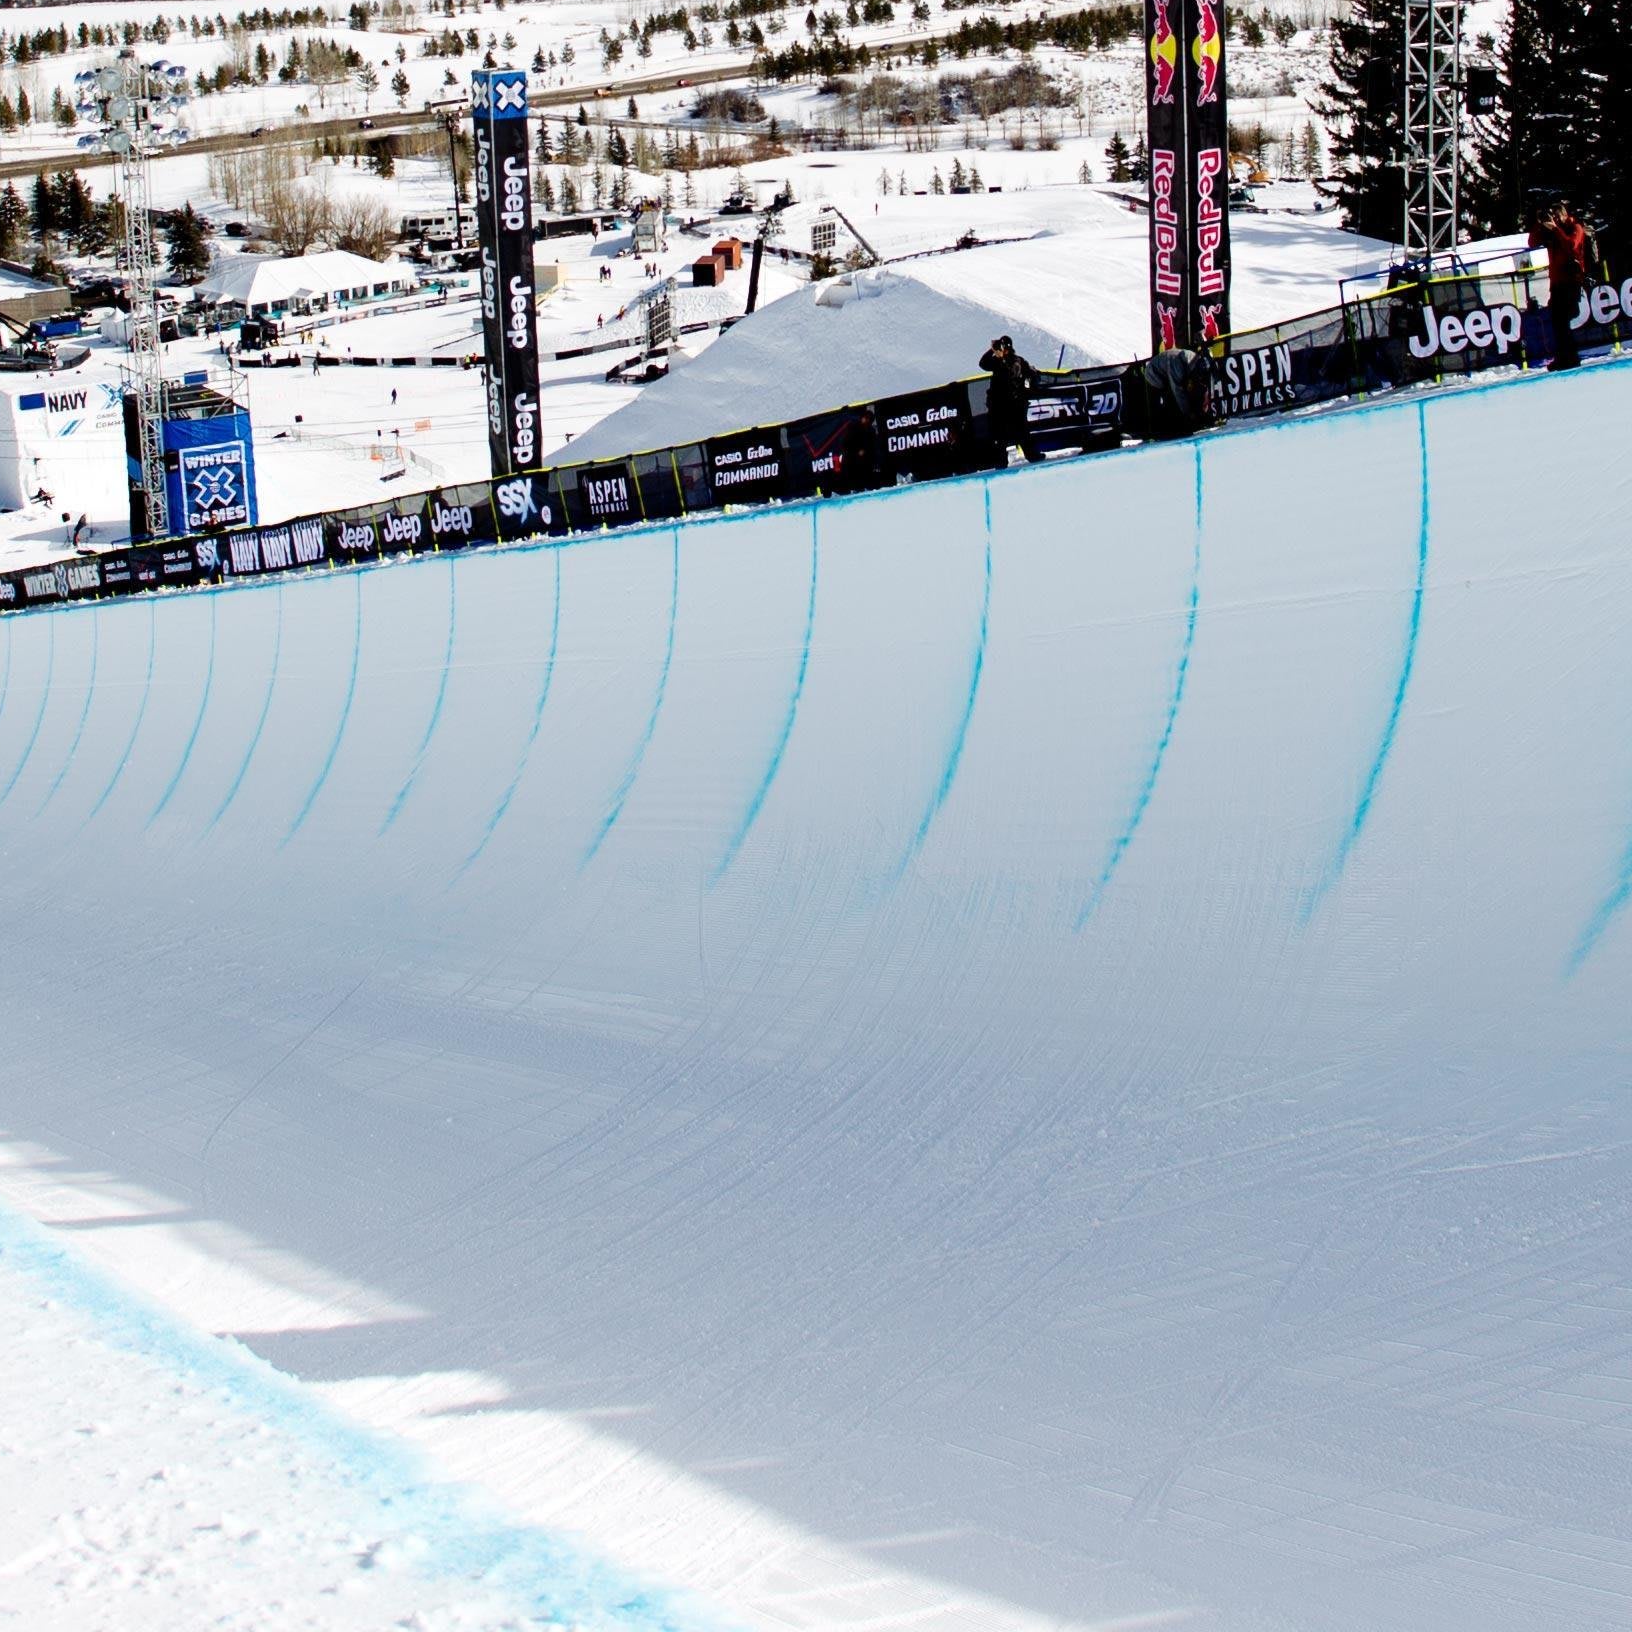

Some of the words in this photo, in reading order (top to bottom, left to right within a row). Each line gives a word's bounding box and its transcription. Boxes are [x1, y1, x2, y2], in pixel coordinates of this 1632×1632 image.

[477, 128, 491, 202] Jeep
[1153, 149, 1178, 225] Red
[1197, 148, 1222, 223] Red
[500, 156, 528, 231] Jeep
[482, 246, 497, 319] Jeep
[1155, 223, 1182, 296] Bull
[1197, 223, 1225, 296] Bull
[507, 275, 532, 348] Jeep
[1408, 304, 1522, 358] Jeep
[48, 391, 87, 413] NAVY
[489, 363, 502, 435] Jeep
[886, 412, 920, 430] CASIO
[1088, 391, 1119, 416] 3D
[1210, 385, 1297, 418] SNOWMASS
[513, 392, 537, 464] Jeep
[184, 449, 242, 470] WINTER
[714, 449, 743, 466] CASIO
[714, 462, 780, 487] COMMANDO
[496, 478, 538, 525] SSX
[589, 477, 629, 505] ASPEN
[338, 521, 375, 551] Jeep
[383, 512, 422, 544] Jeep
[430, 496, 473, 535] Jeep
[231, 540, 261, 574] NAVY
[261, 534, 293, 569] NAVY
[293, 526, 325, 564] NAVY
[23, 571, 57, 598] WINTER
[68, 563, 102, 590] GAMES
